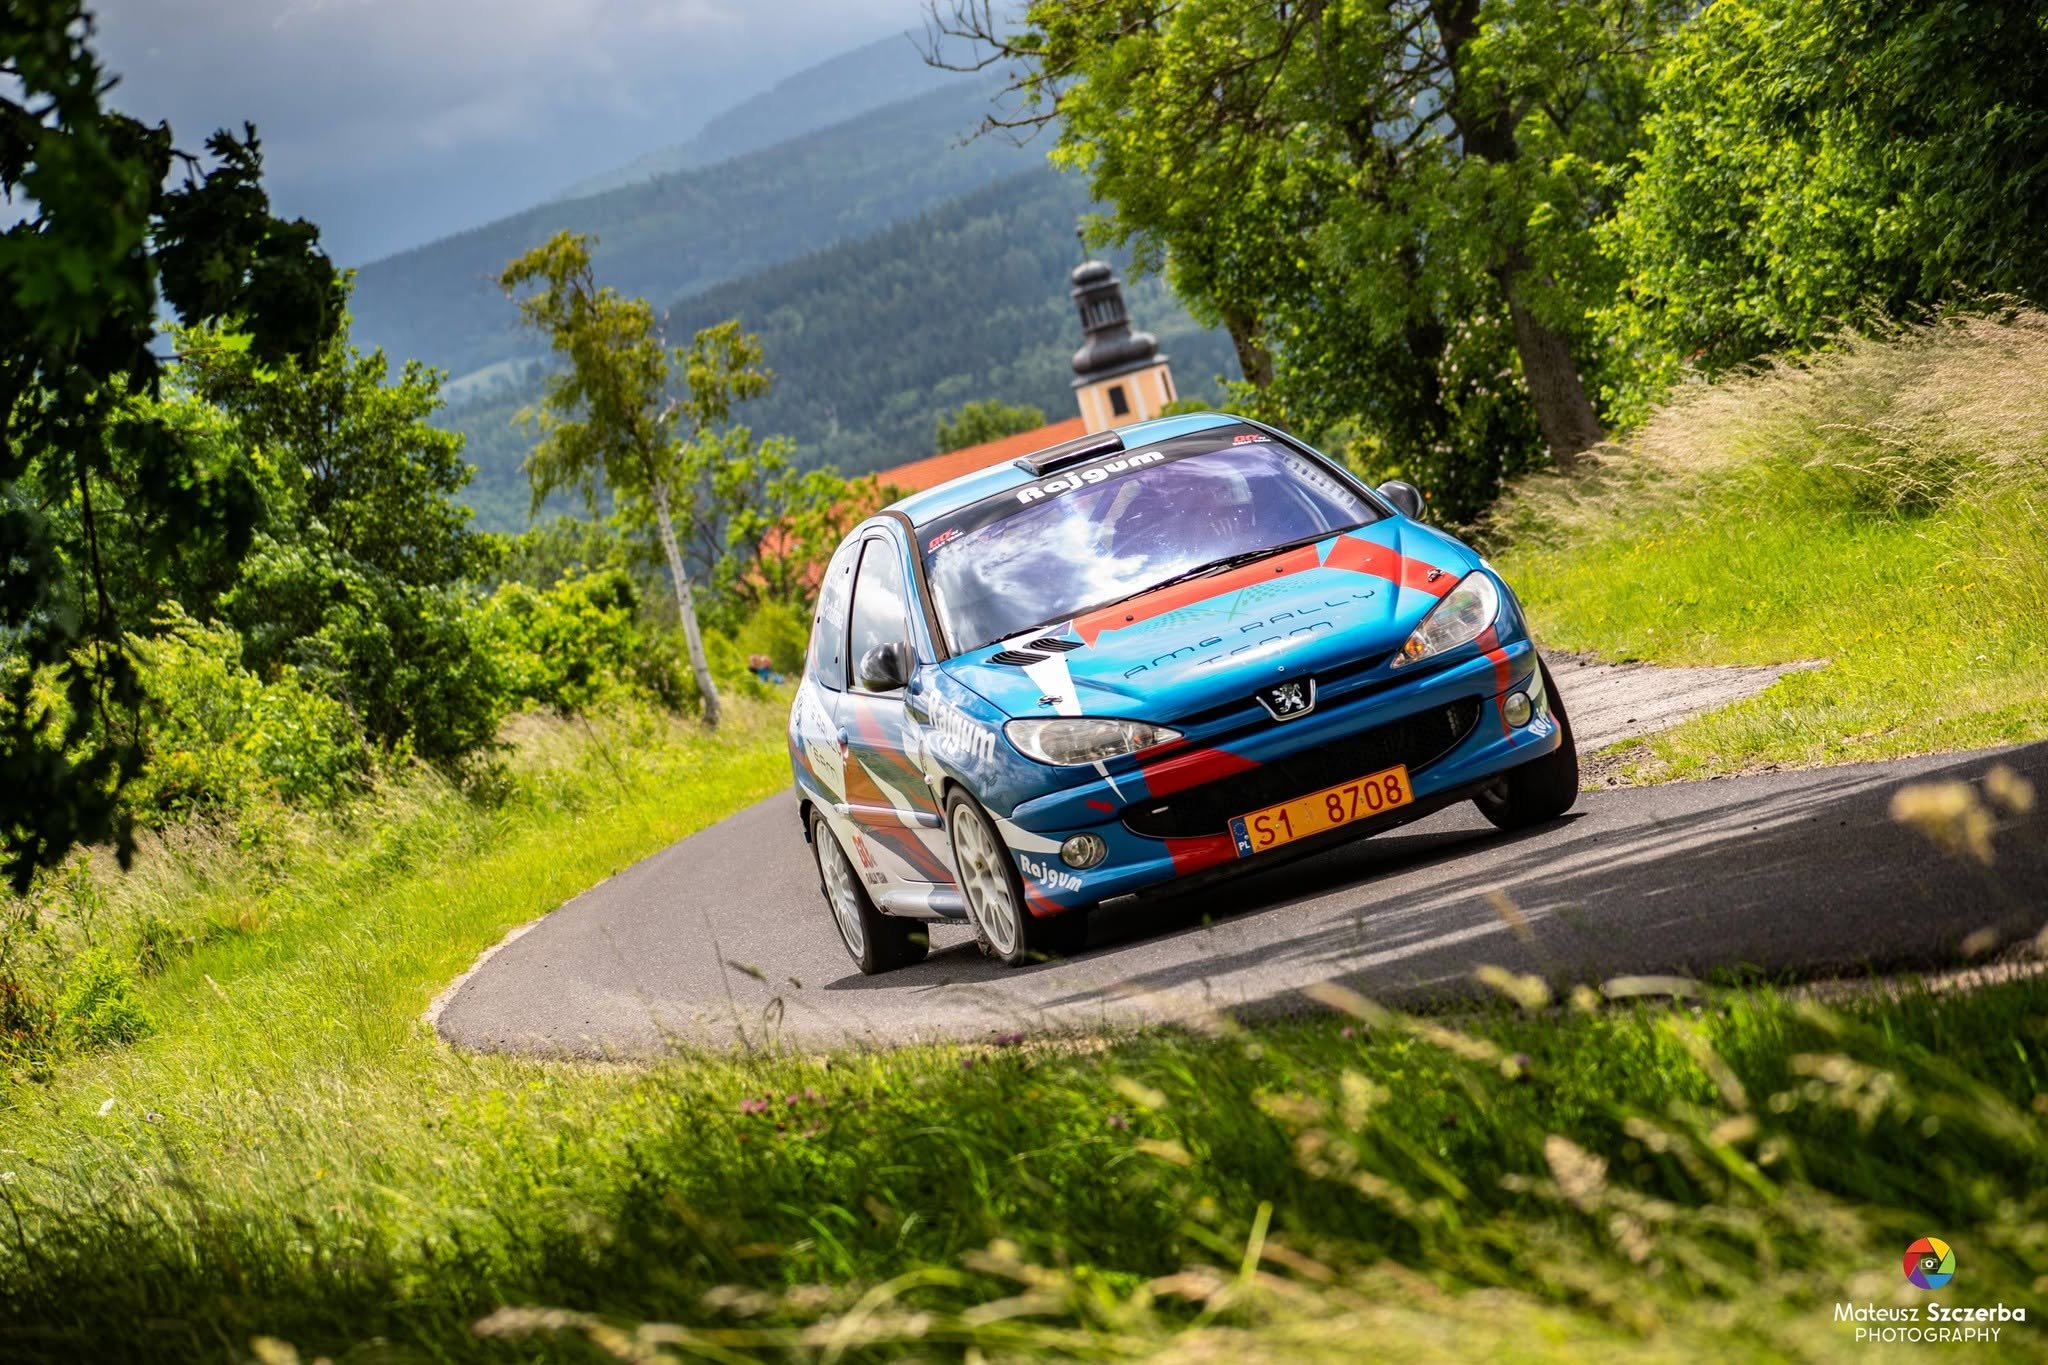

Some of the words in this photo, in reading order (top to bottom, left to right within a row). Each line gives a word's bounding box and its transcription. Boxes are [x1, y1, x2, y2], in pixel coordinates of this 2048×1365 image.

[1016, 451, 1165, 504] Rajgum
[1240, 590, 1375, 633] RALLY
[1254, 808, 1293, 846] S1
[1325, 774, 1403, 823] 8708
[1239, 840, 1251, 851] PL
[1020, 854, 1082, 892] Rajgum
